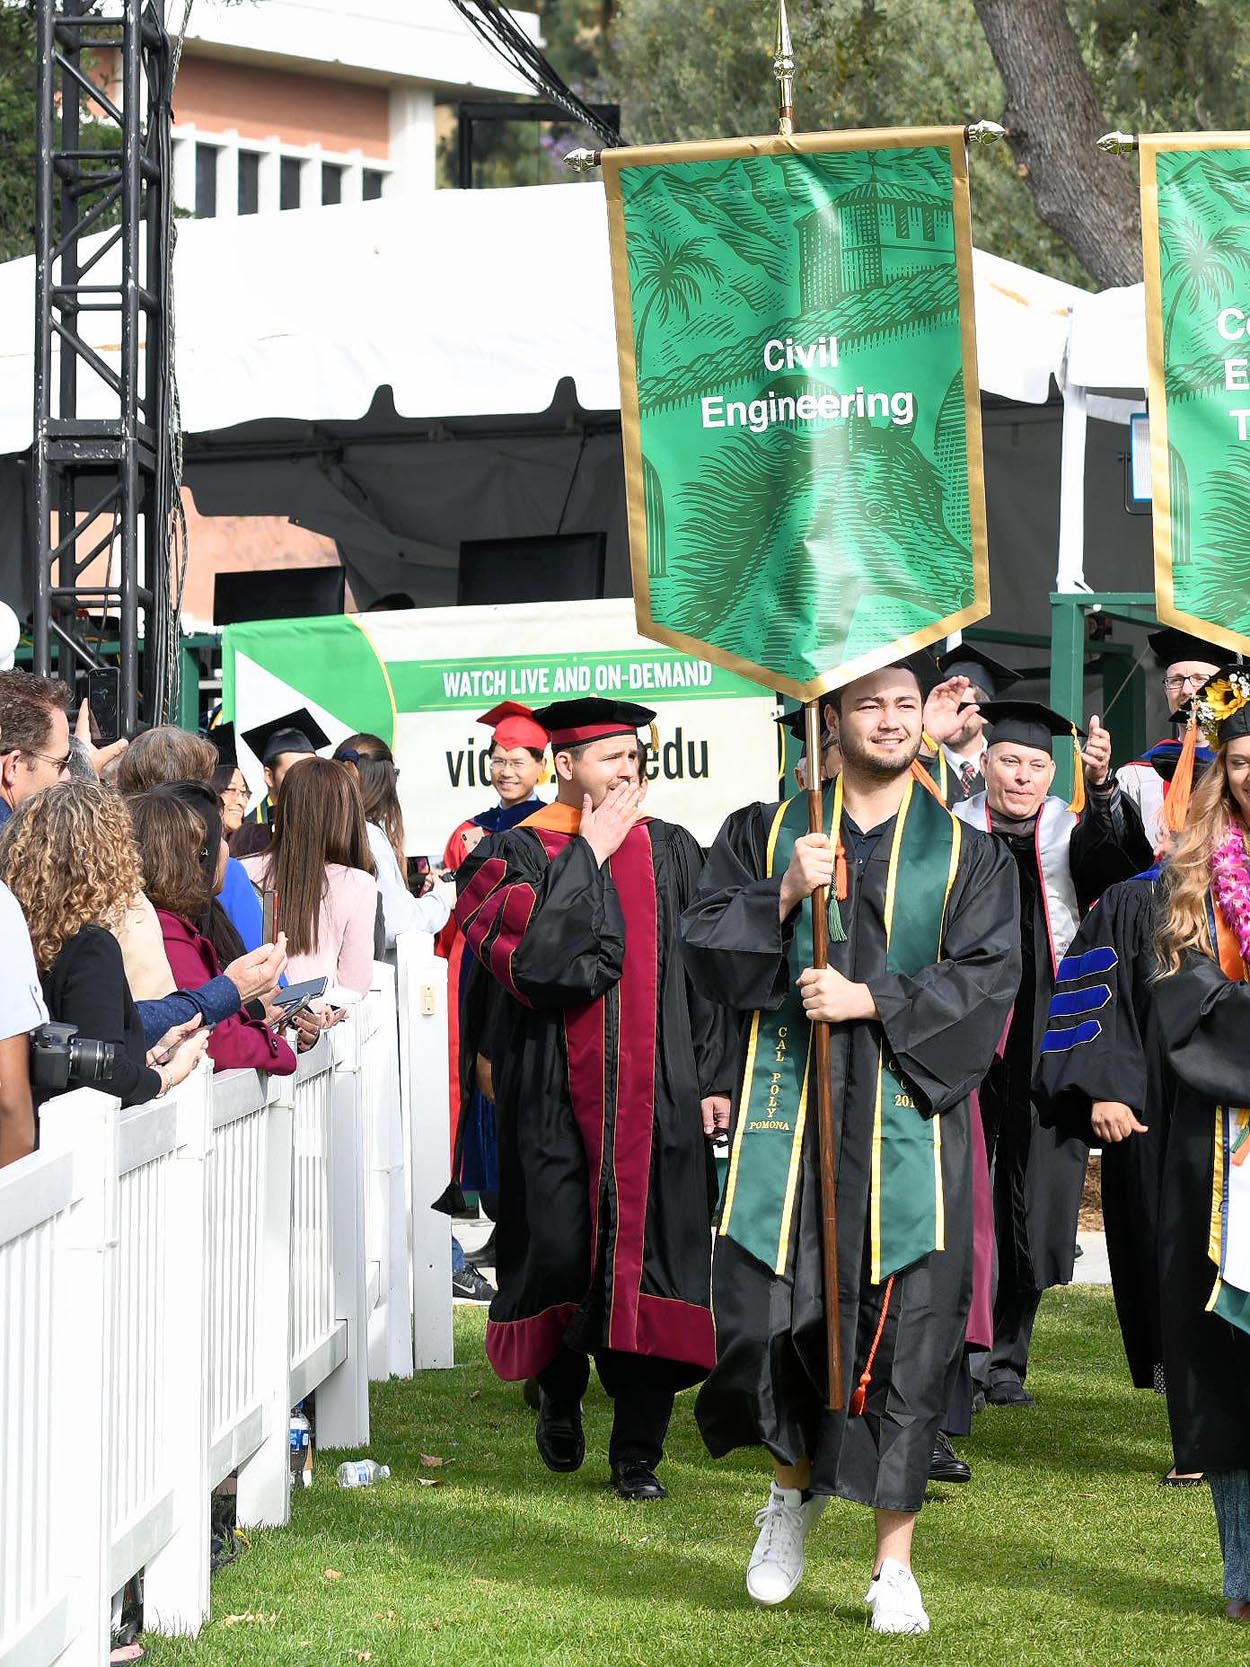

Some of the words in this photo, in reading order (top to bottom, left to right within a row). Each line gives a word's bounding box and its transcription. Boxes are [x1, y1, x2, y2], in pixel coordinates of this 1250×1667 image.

[763, 336, 839, 371] Civil
[701, 386, 914, 433] Engineering
[443, 669, 506, 697] WATCH
[510, 667, 549, 694] LIVE
[553, 664, 591, 692] AND
[595, 660, 713, 691] ON-DEMAND
[775, 1026, 788, 1062] CAL
[766, 1073, 782, 1118] POLY
[895, 1094, 916, 1108] 201
[750, 1120, 790, 1131] POMONA
